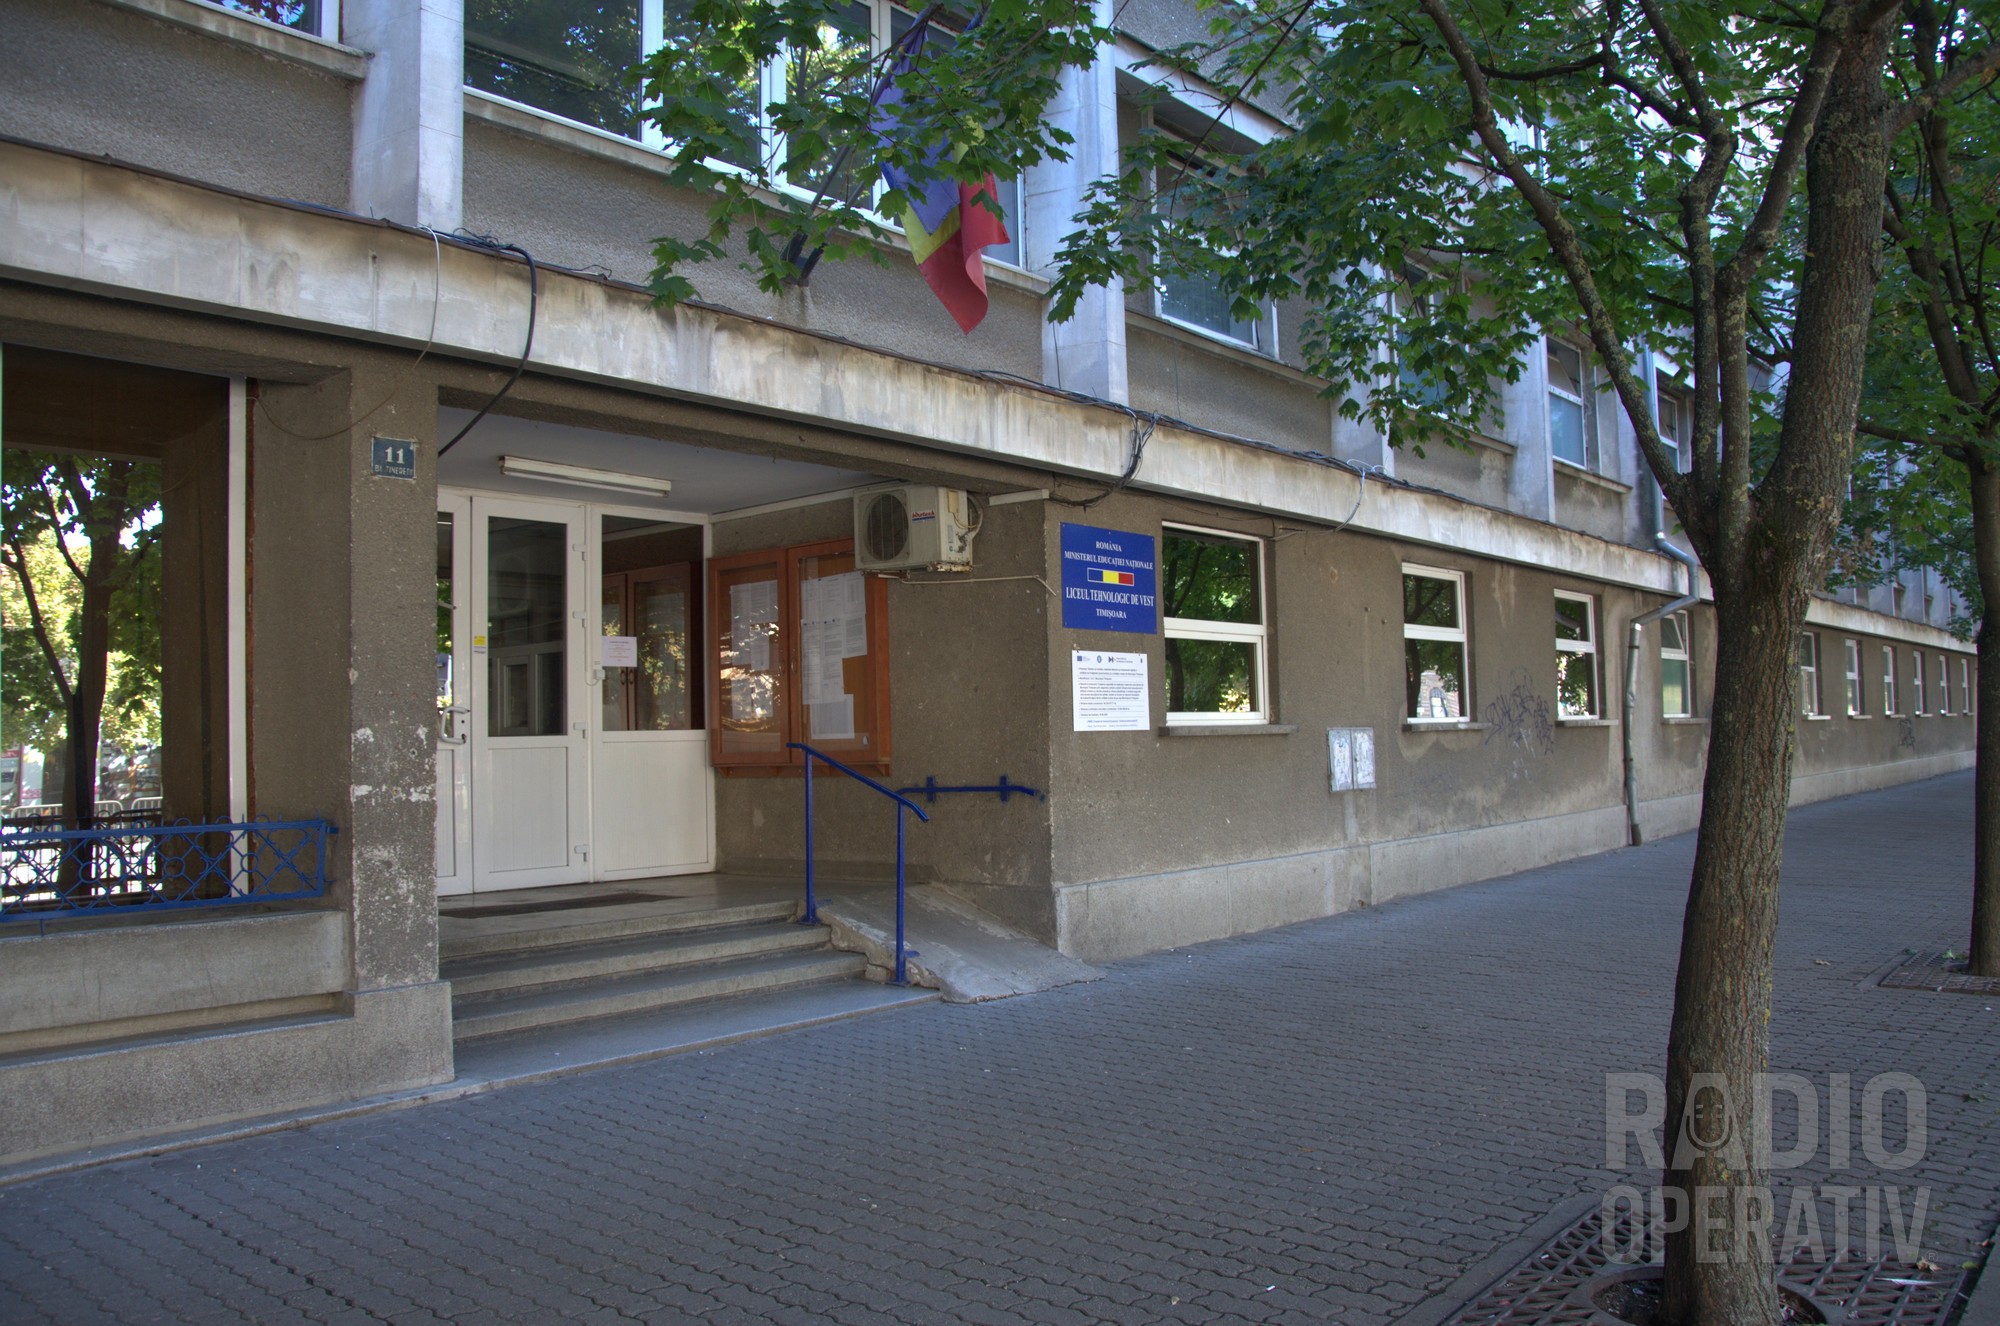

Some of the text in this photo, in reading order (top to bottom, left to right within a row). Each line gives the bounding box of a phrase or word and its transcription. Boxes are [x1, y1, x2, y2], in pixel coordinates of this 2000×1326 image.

[385, 447, 404, 464] 11
[1095, 541, 1122, 552] ROMÂNIA
[1064, 550, 1097, 563] MINISTERUL
[1066, 586, 1154, 607] LICEUL TEHNOLOGIC DE VEST
